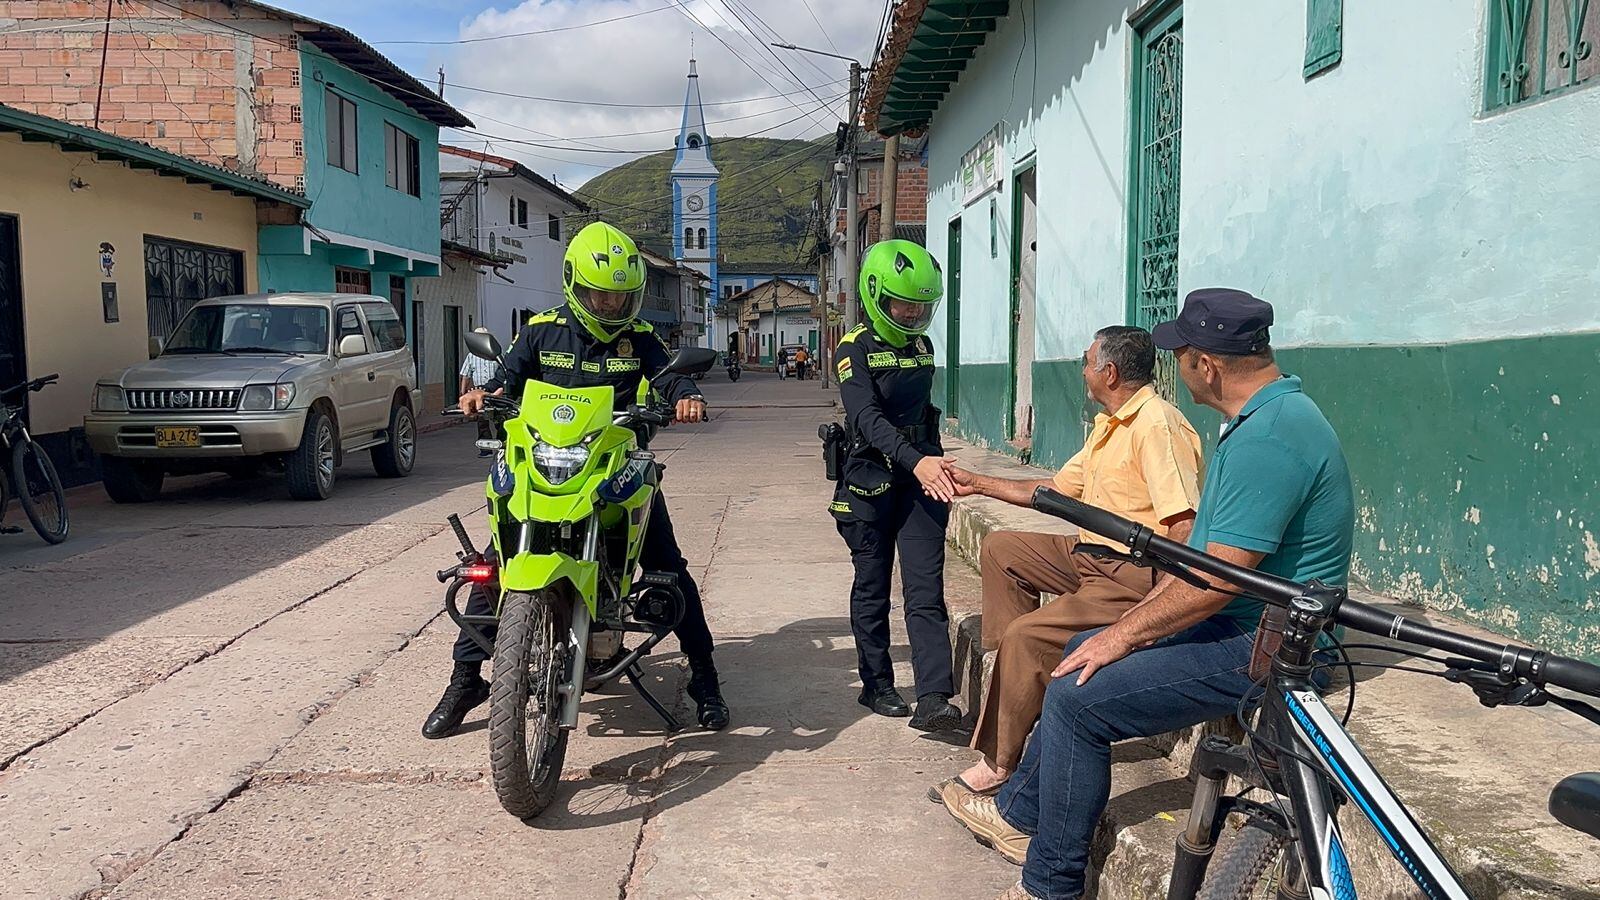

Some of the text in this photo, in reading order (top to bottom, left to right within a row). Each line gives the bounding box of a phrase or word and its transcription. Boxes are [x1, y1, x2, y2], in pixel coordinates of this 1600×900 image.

[540, 393, 592, 404] POLICÍA
[617, 460, 645, 488] POLIC
[849, 482, 891, 496] POLICÍA
[1285, 691, 1333, 757] TIMBERLINE
